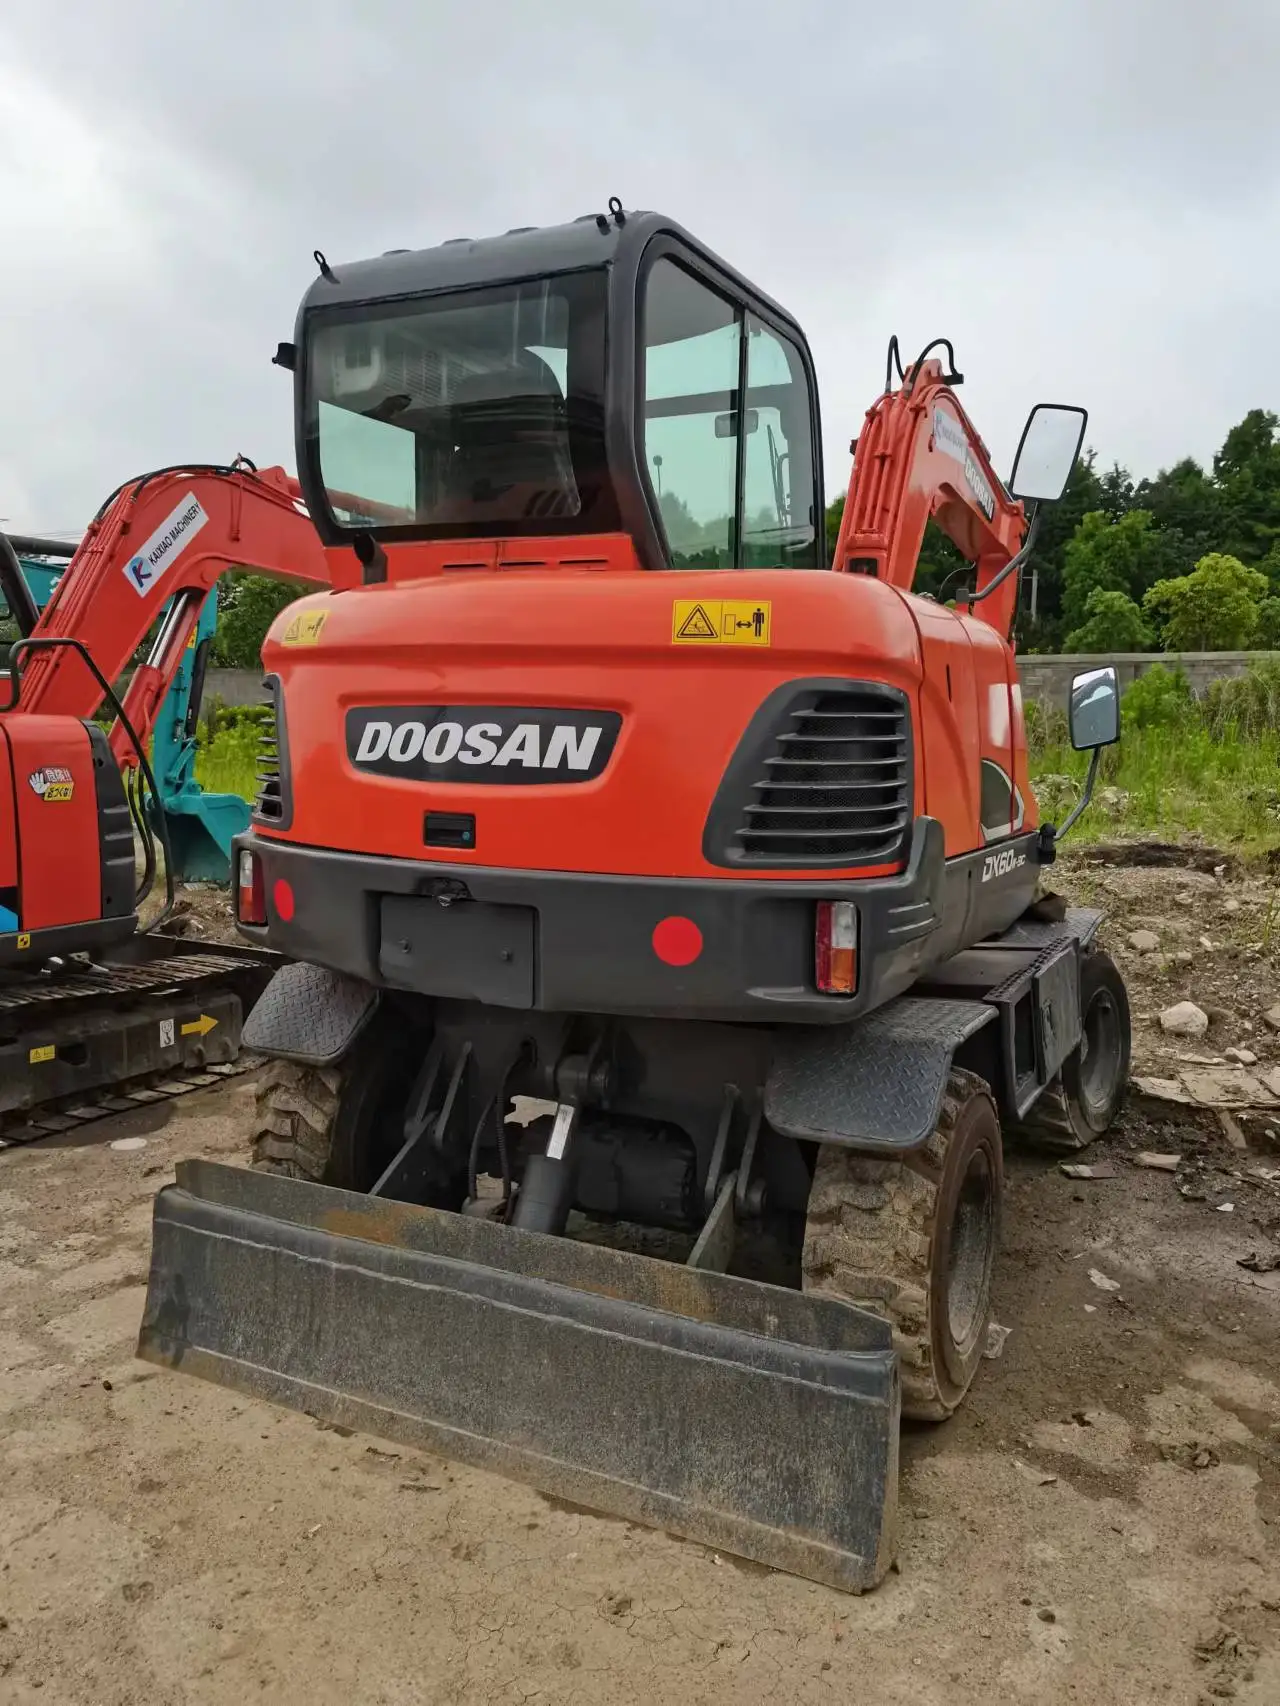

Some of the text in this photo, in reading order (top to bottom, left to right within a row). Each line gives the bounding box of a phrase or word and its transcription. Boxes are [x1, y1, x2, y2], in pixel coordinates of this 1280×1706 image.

[148, 535, 173, 566] KAIXIAO
[169, 502, 202, 540] MACHINERY
[355, 721, 603, 770] DOOSAN
